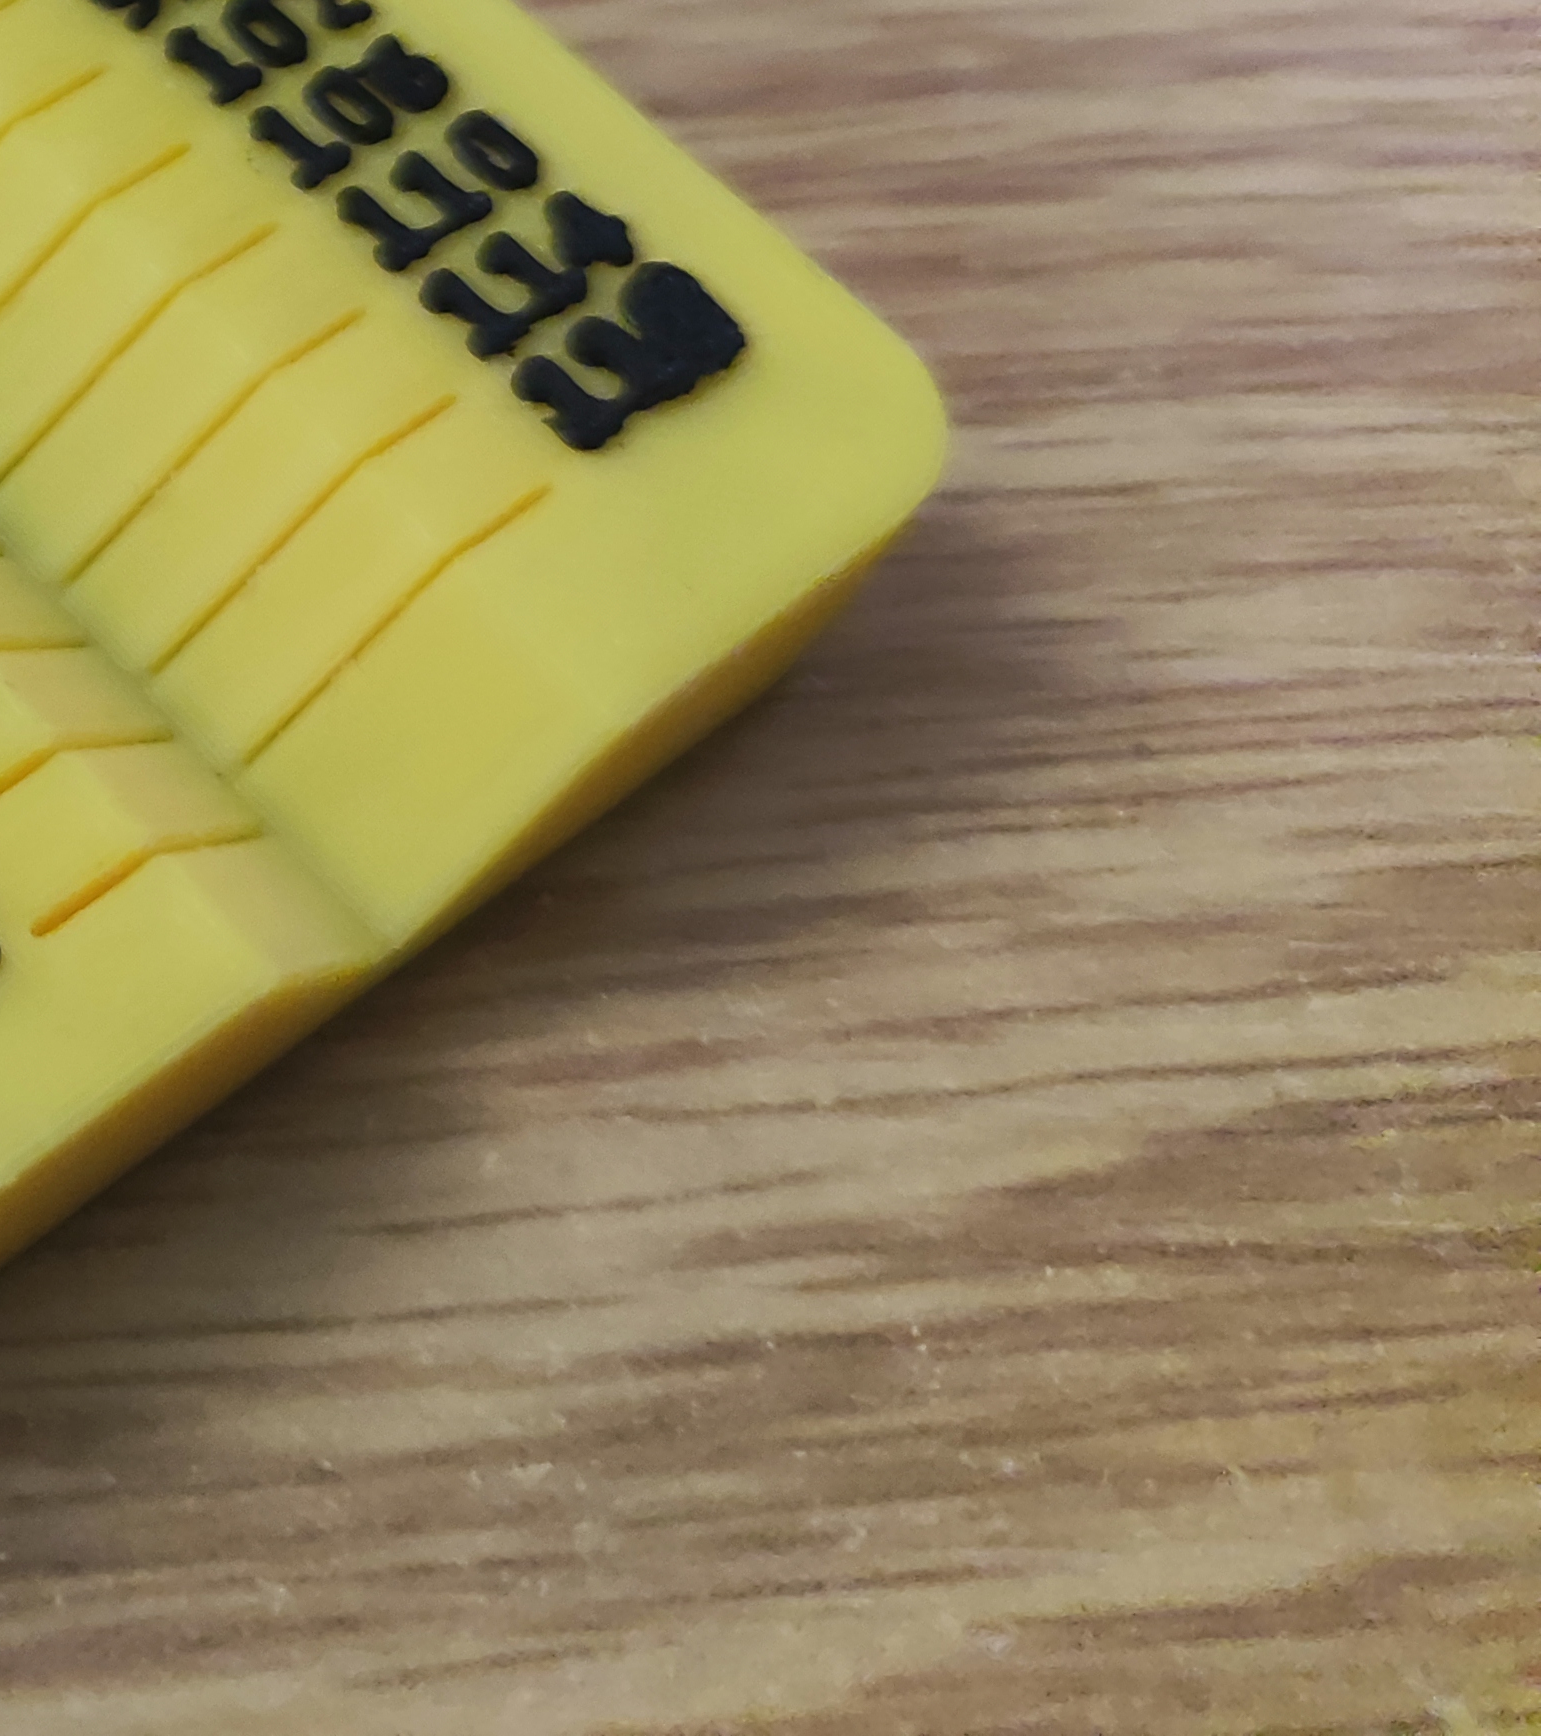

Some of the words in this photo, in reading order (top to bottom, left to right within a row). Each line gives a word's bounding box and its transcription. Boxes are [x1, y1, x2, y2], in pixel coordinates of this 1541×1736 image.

[249, 33, 449, 191] 106
[336, 109, 539, 272] 110
[418, 190, 634, 361] 114
[510, 261, 745, 450] 11
